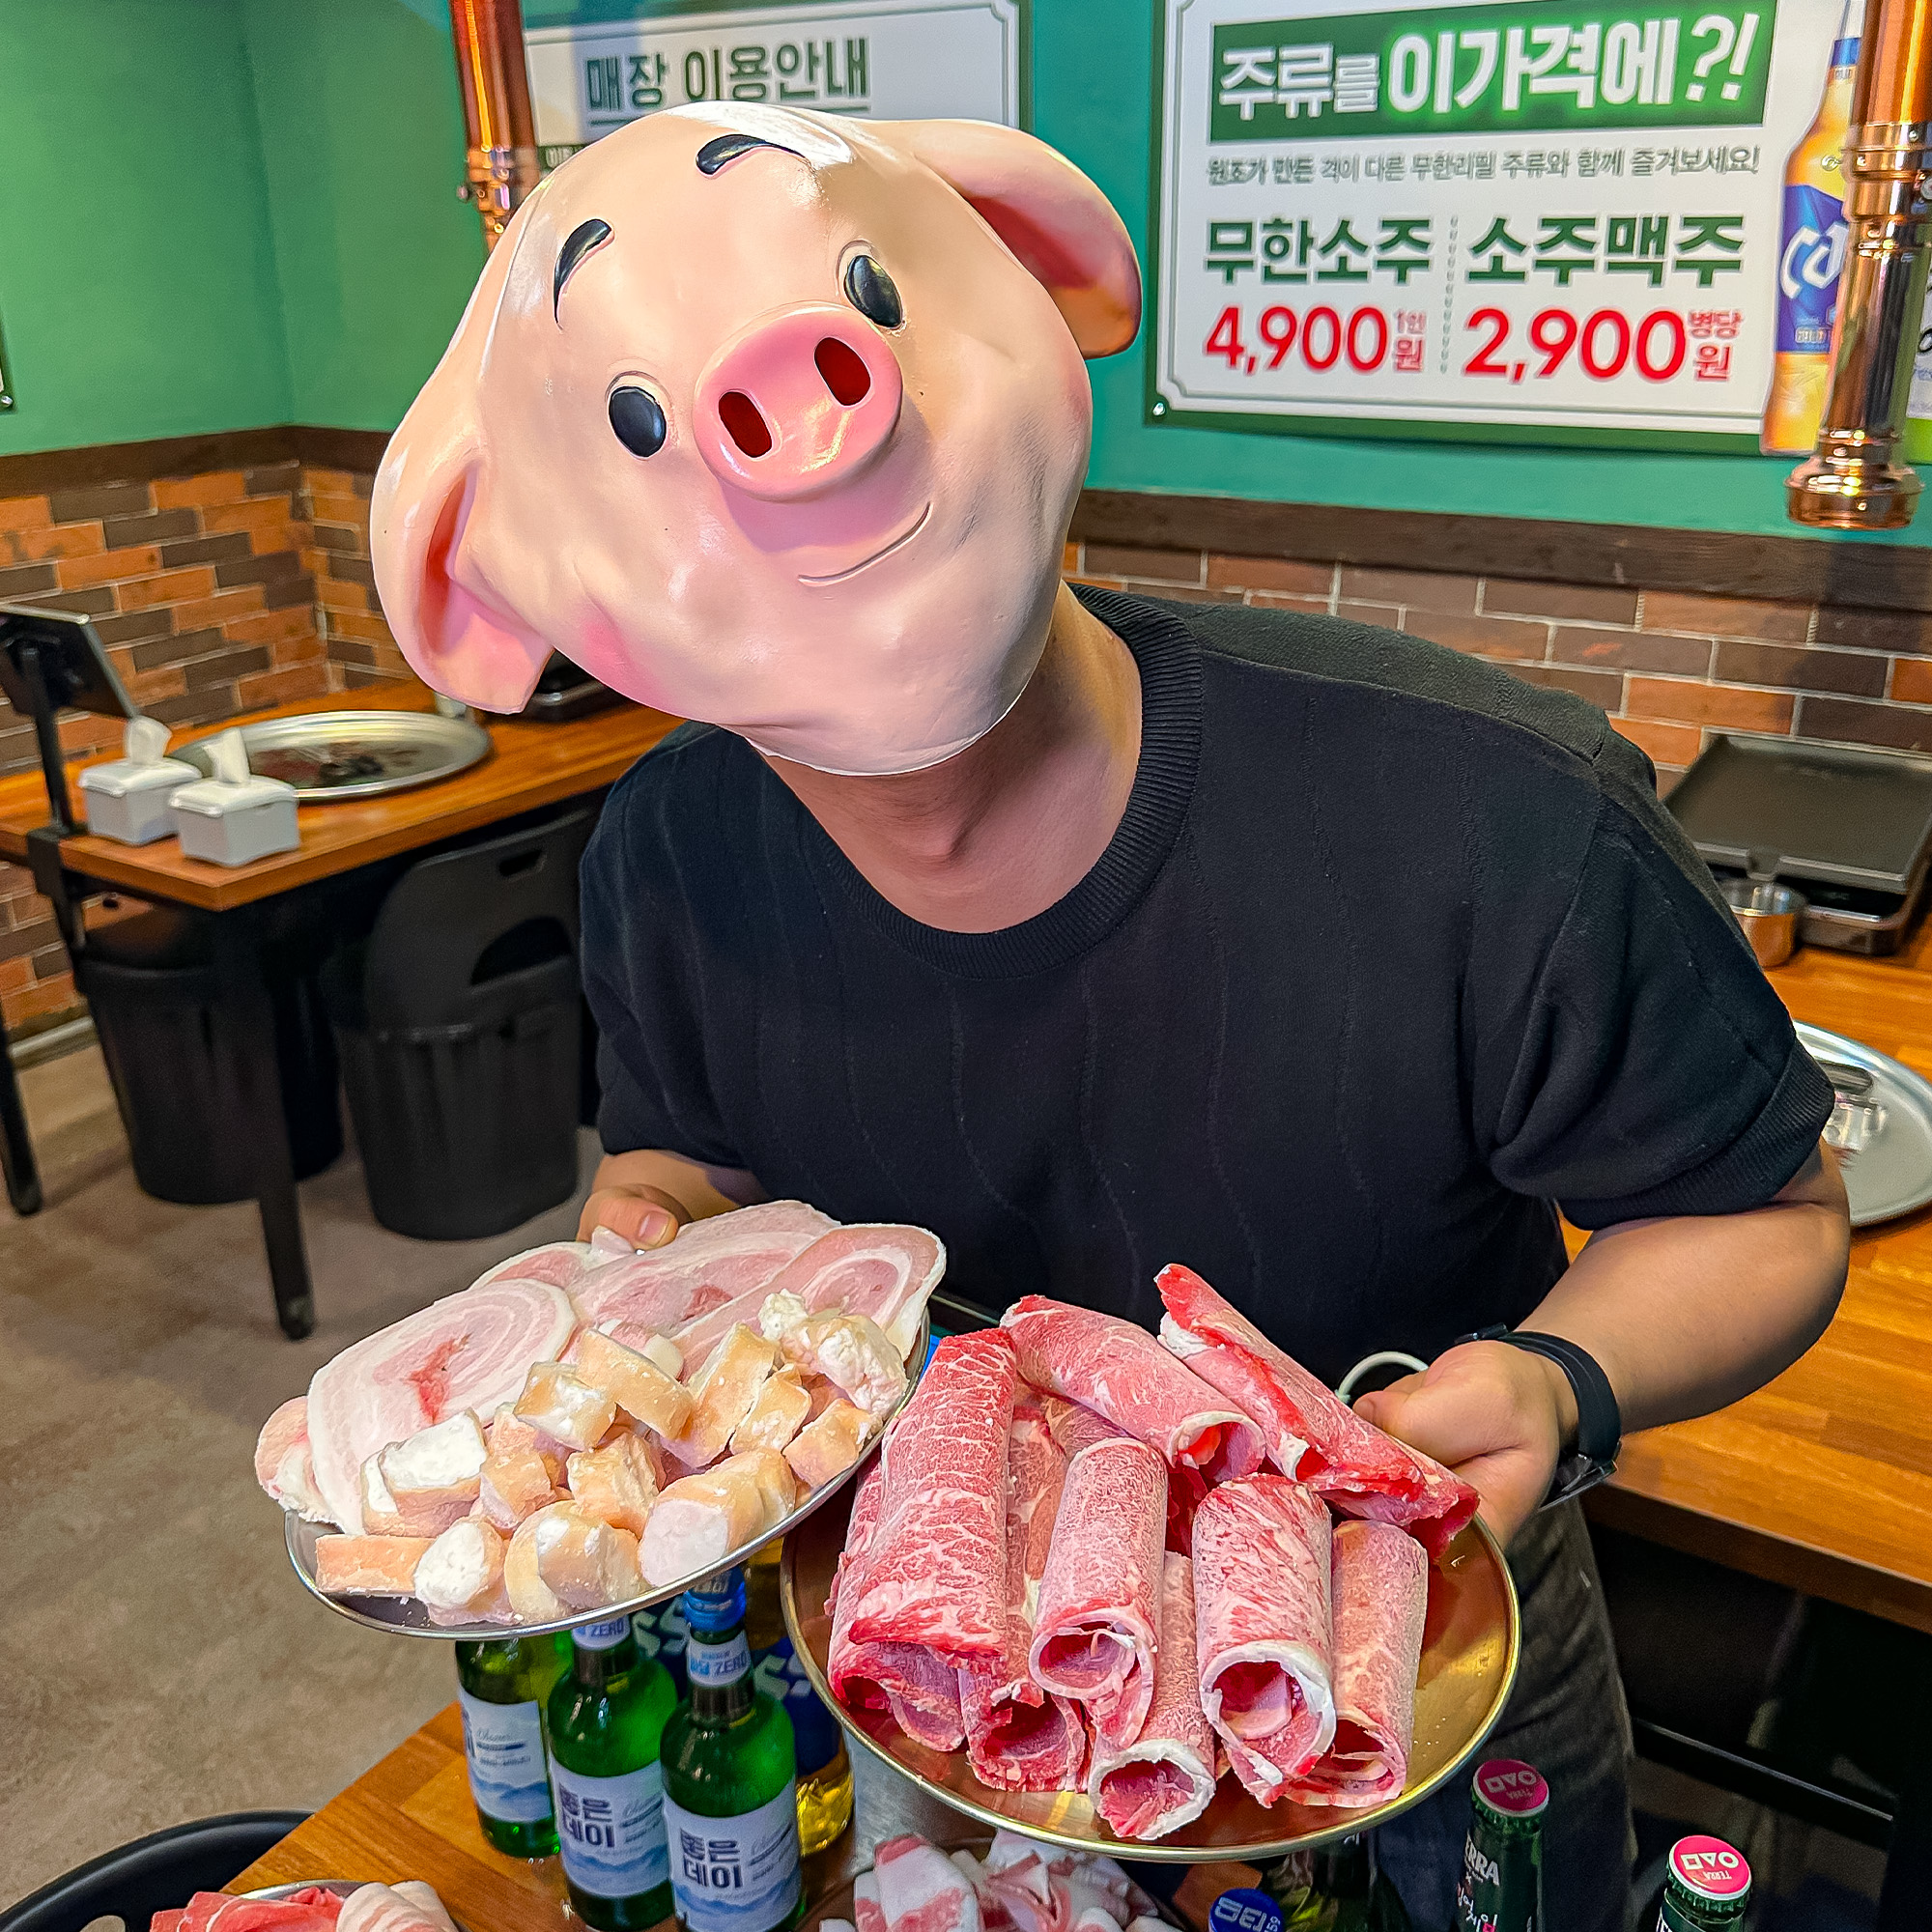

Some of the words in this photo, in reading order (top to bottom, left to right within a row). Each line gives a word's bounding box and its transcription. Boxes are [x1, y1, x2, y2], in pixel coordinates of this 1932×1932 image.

[584, 50, 668, 110] 매장
[683, 37, 868, 103] 이용안내
[1218, 42, 1380, 121] 주류를
[1273, 153, 1315, 185] 만든
[1364, 152, 1406, 183] 다른
[1411, 150, 1496, 182] 무한리필
[1501, 148, 1571, 179] 주류와
[1577, 146, 1625, 178] 함께
[1205, 216, 1432, 286] 무한소주
[1464, 213, 1744, 290] 소주맥주
[1204, 305, 1388, 377] 4,900
[1394, 338, 1424, 373] 원
[1689, 309, 1743, 340] 병당
[1463, 306, 1687, 385] 2,900
[1693, 343, 1731, 383] 원
[562, 1809, 615, 1848] 데이
[680, 1828, 741, 1862] 좋은
[683, 1855, 743, 1889] 데이
[1702, 1870, 1732, 1881] TERRA
